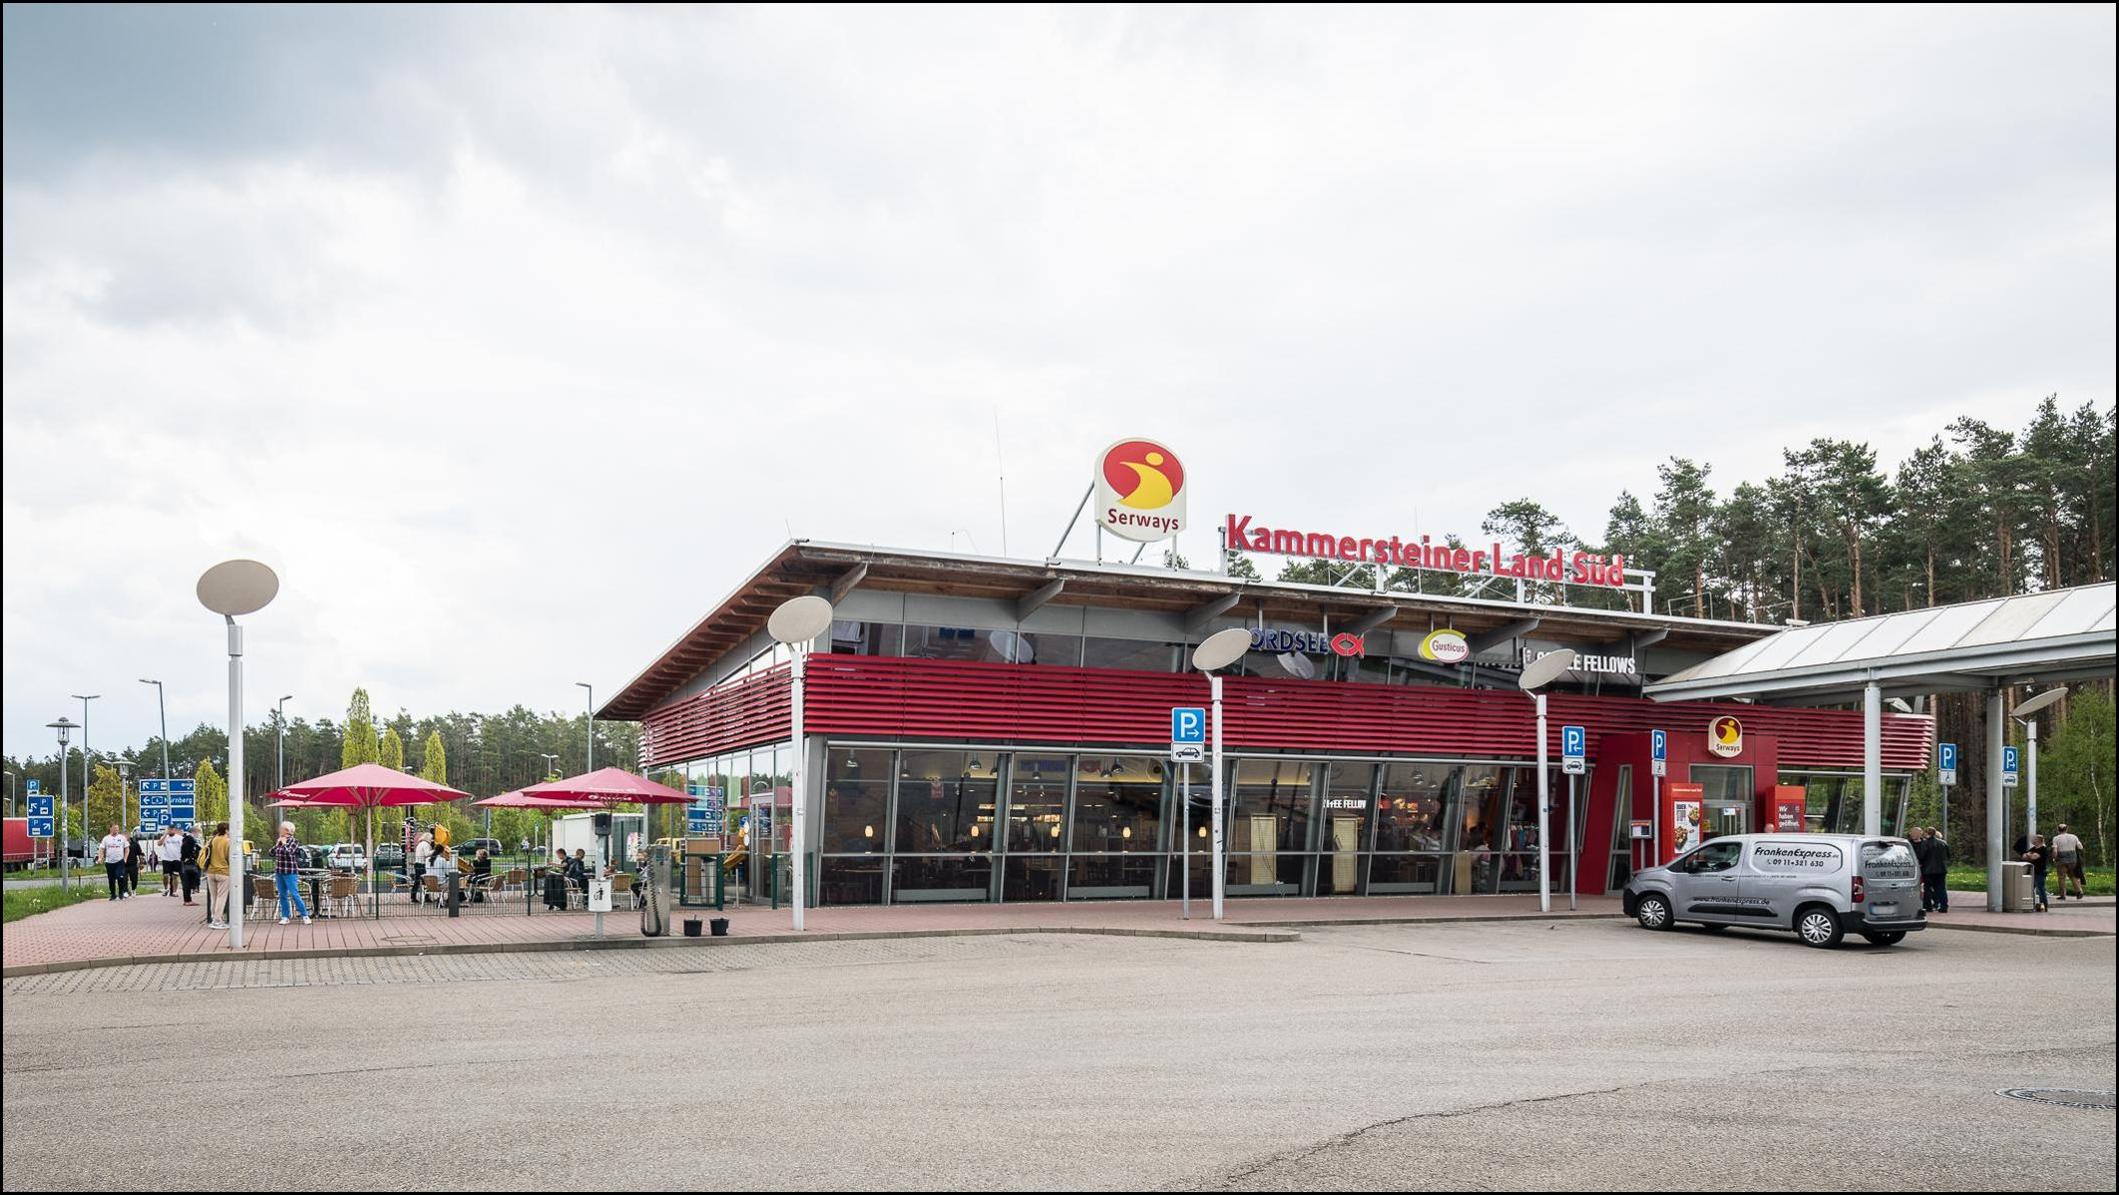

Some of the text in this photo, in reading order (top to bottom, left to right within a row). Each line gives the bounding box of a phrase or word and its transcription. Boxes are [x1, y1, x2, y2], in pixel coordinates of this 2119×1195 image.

[1108, 508, 1179, 533] Serways
[1227, 513, 1624, 587] Kammersteiner Land Süd
[1249, 627, 1329, 654] ORDSEE
[1432, 640, 1466, 652] Gusticus
[1583, 654, 1636, 674] FELLOWS
[1180, 712, 1198, 738] P
[1568, 730, 1580, 753] P
[1655, 734, 1663, 756] P
[1943, 747, 1953, 768] P
[2006, 750, 2015, 769] P
[30, 781, 37, 789] P
[160, 814, 169, 824] P
